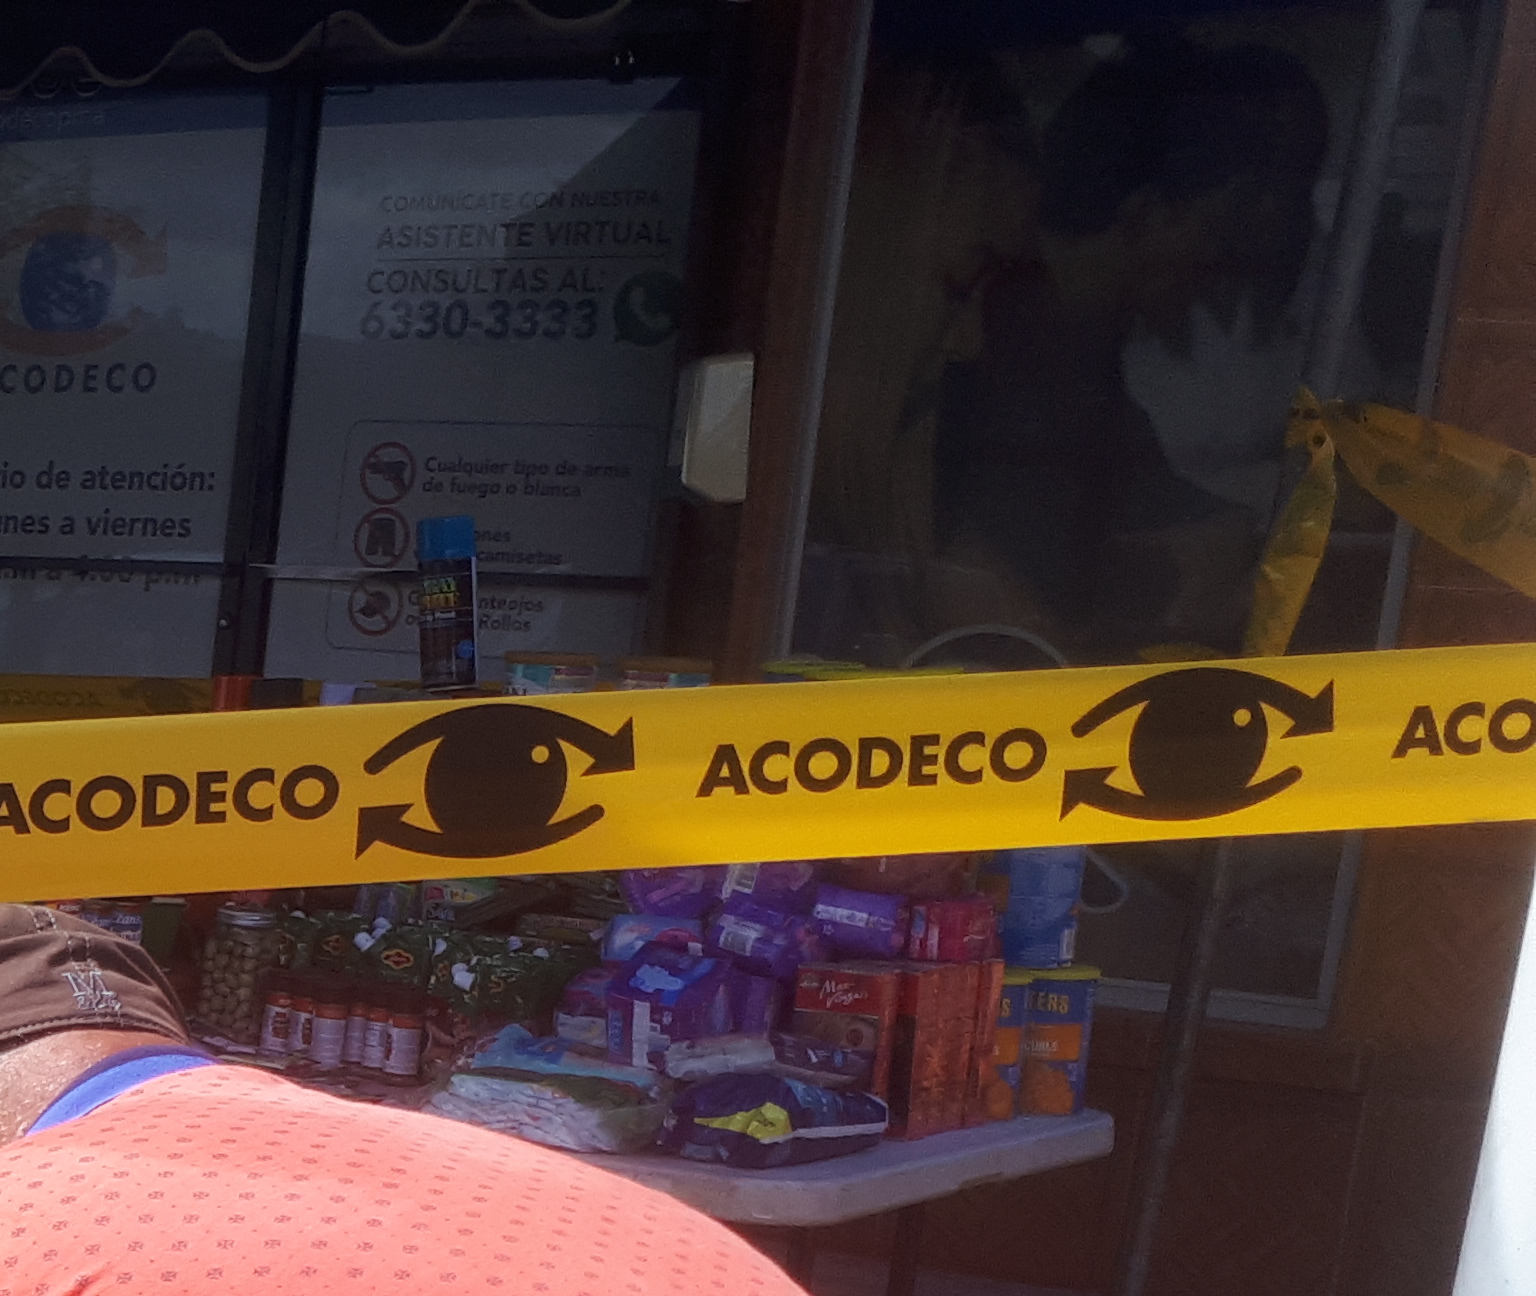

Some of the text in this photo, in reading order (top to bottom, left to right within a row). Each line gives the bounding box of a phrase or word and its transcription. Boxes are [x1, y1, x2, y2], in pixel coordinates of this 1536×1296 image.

[518, 190, 565, 210] CON
[376, 220, 673, 249] ASISTENTE VIRTUAL
[366, 267, 550, 295] CONSULTAS
[359, 299, 599, 341] 6330-3333
[35, 460, 70, 491] de
[79, 461, 216, 492] atención:
[424, 455, 511, 478] Cualquier
[556, 461, 576, 477] de
[422, 477, 443, 494] de
[449, 480, 500, 499] fuego
[59, 515, 76, 535] a
[86, 507, 193, 539] viernes
[695, 727, 1049, 799] ACODECO
